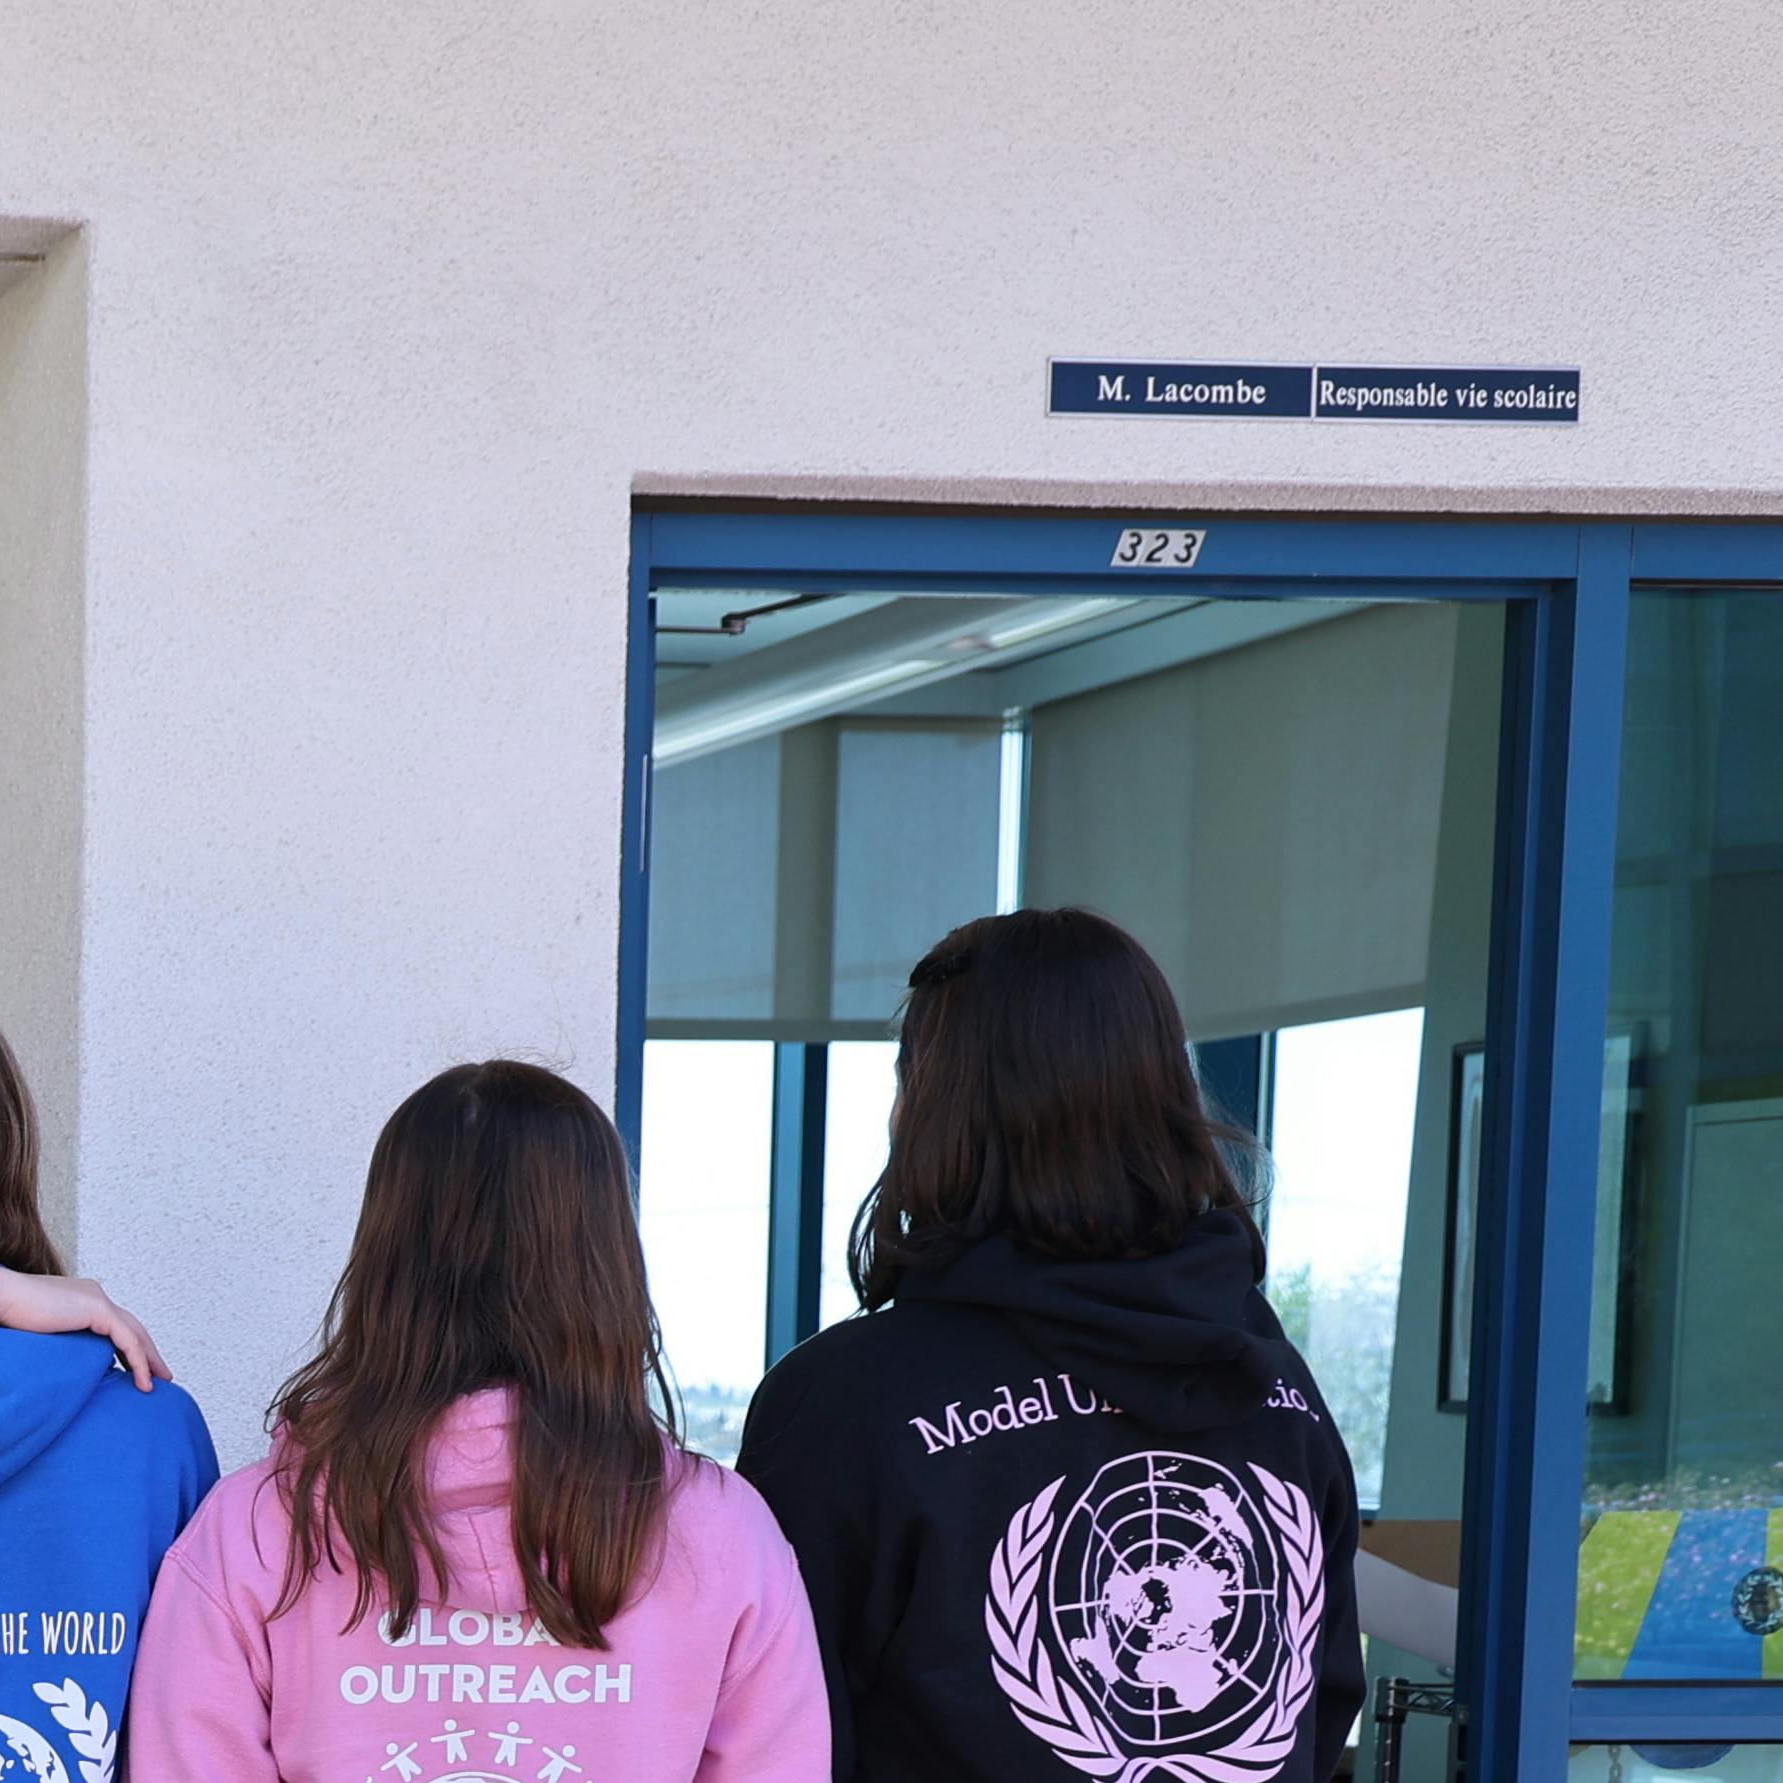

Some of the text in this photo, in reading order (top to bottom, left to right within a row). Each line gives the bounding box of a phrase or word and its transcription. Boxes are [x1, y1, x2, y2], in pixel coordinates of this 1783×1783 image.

[1097, 375, 1267, 404] M. Lacombe
[1319, 380, 1577, 411] Responsable vie scolaire
[1118, 531, 1199, 565] 323
[908, 1377, 1059, 1455] Model
[41, 1611, 126, 1655] WORLD
[378, 1607, 562, 1647] GLOBA
[339, 1664, 632, 1705] OUTREACH
